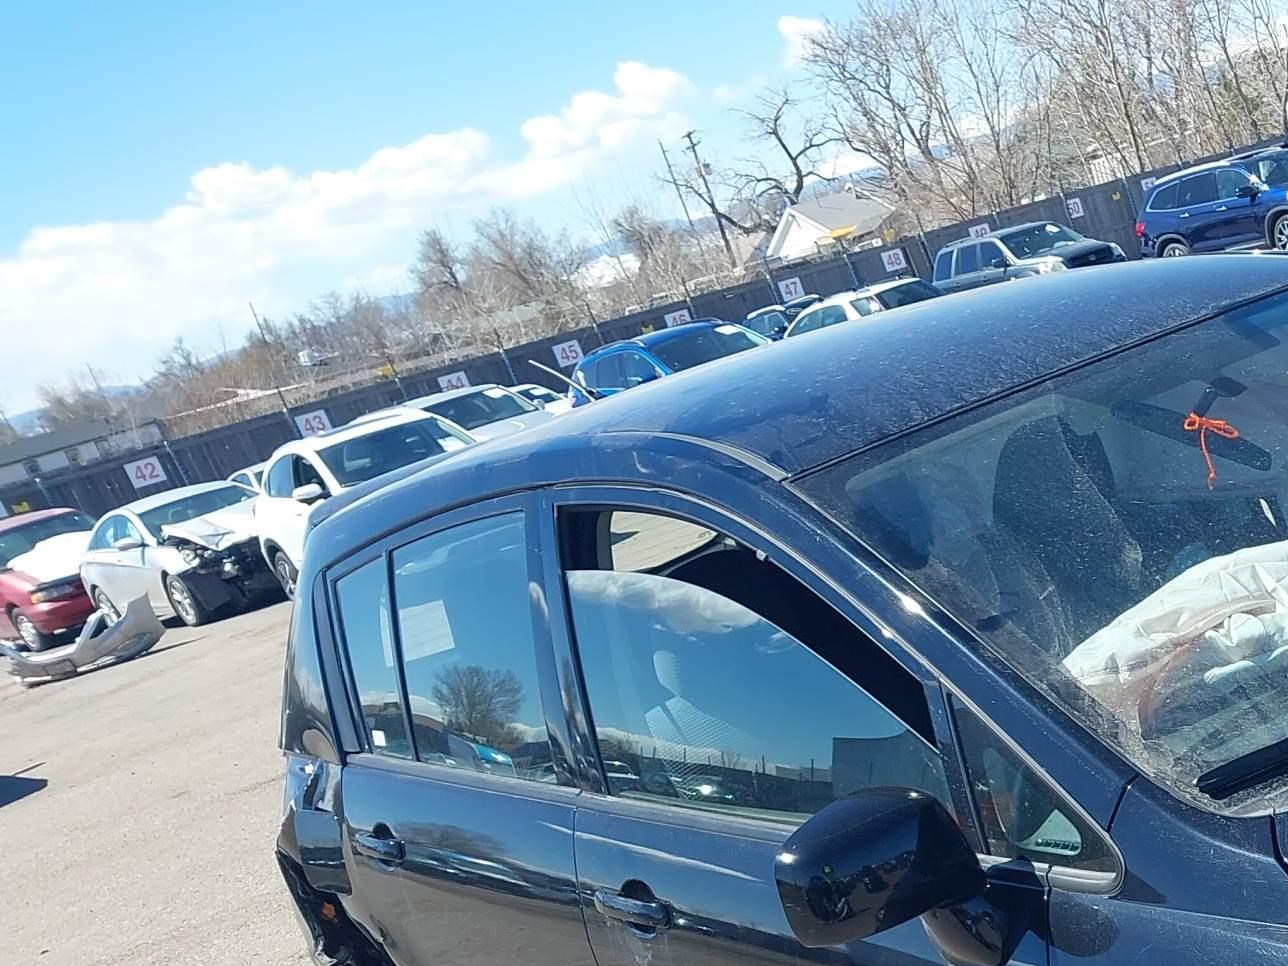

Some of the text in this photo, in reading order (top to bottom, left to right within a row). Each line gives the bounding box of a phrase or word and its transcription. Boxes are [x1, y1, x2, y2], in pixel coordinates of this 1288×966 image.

[1067, 201, 1080, 216] 50
[887, 253, 902, 268] 48
[784, 281, 798, 297] 47
[670, 314, 687, 326] 46
[561, 344, 579, 362] 45
[446, 375, 466, 391] 44
[305, 414, 326, 433] 43
[135, 461, 159, 482] 42
